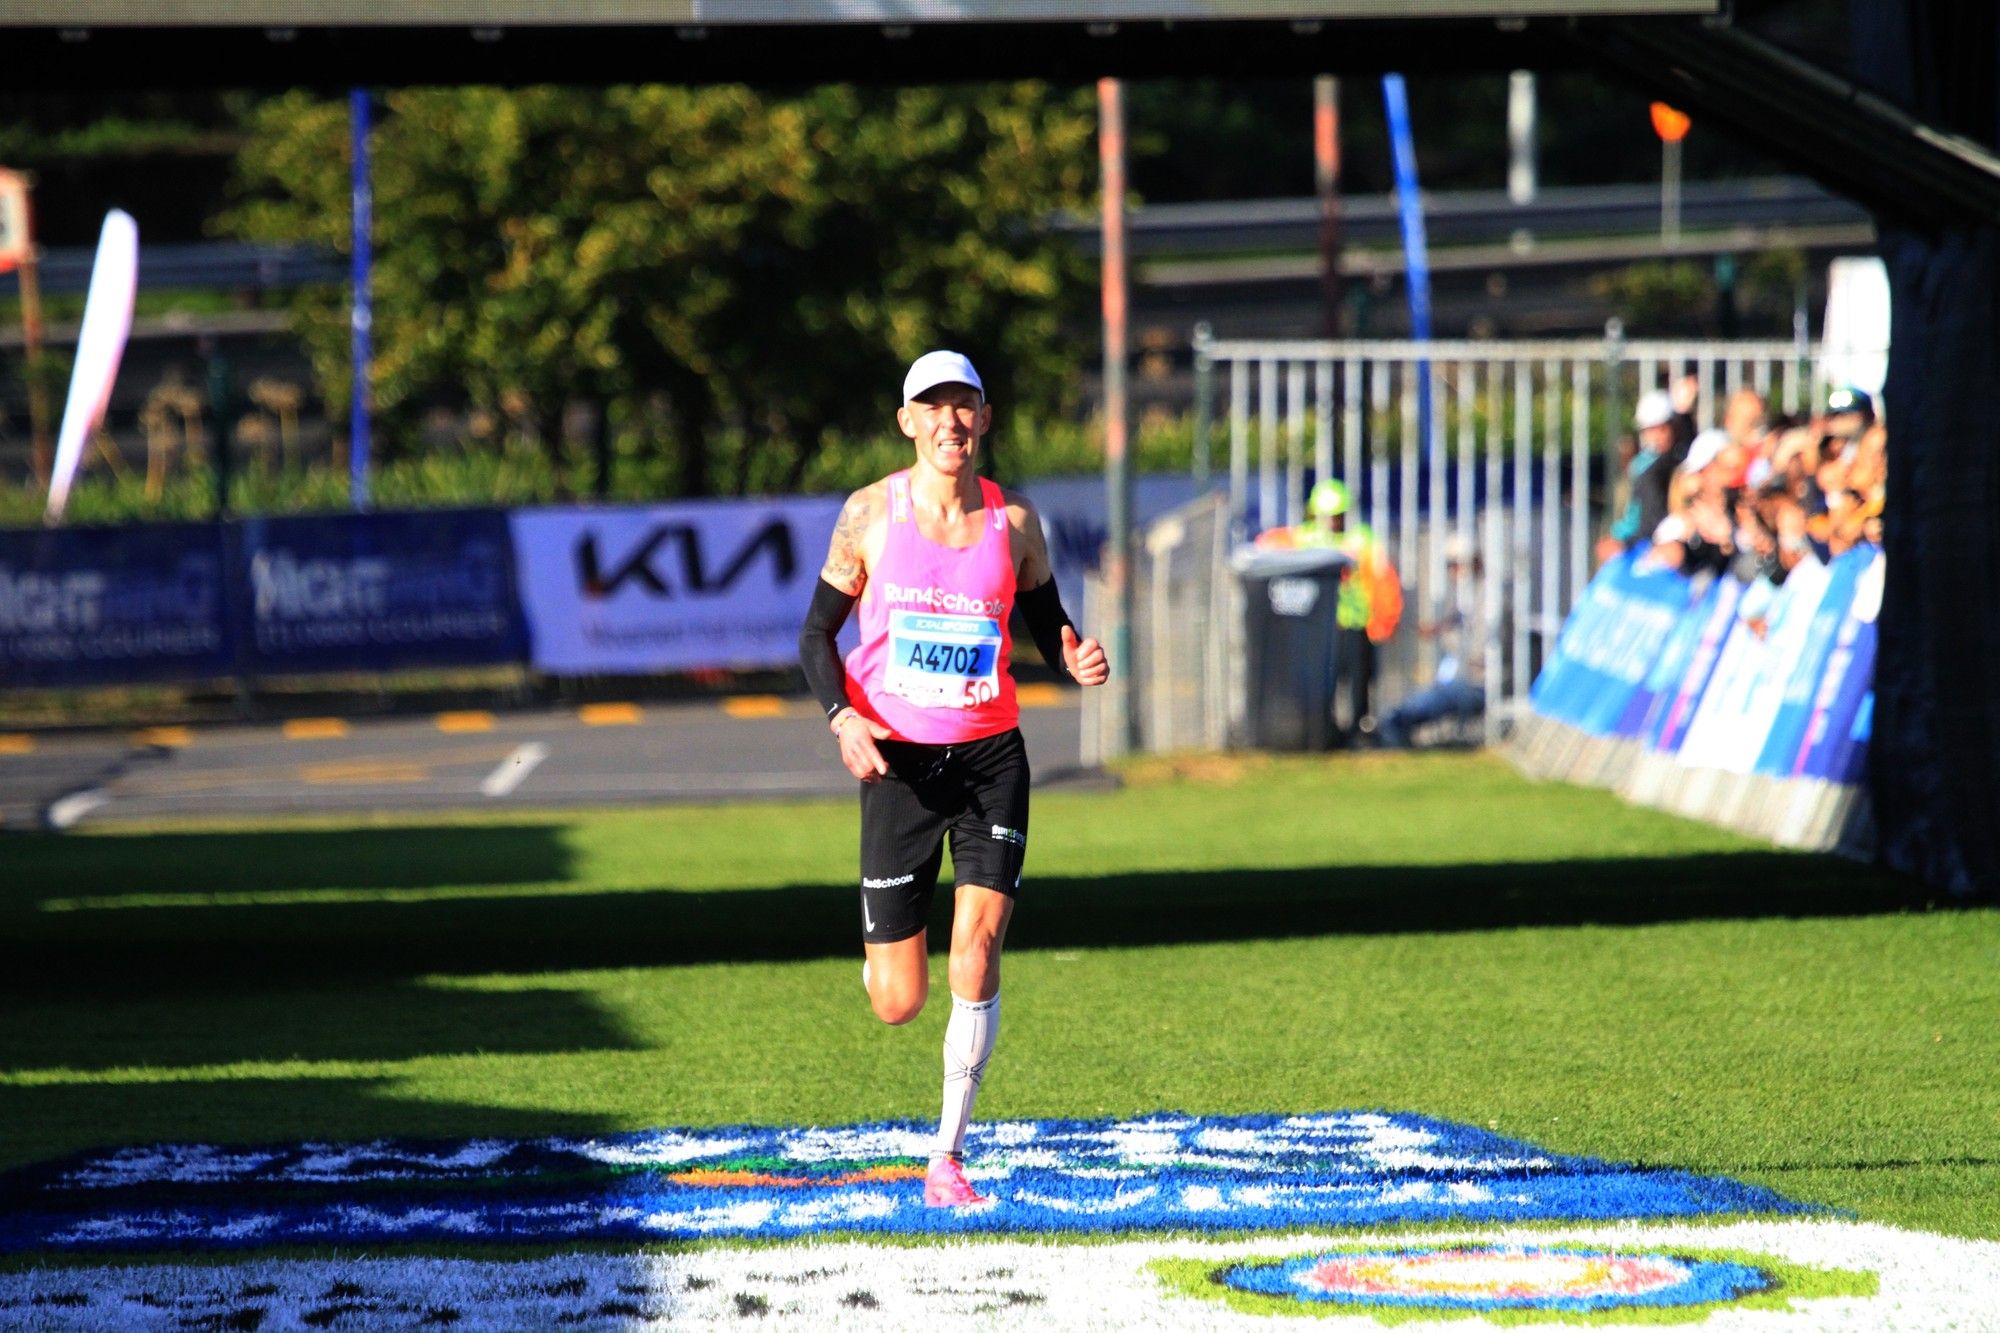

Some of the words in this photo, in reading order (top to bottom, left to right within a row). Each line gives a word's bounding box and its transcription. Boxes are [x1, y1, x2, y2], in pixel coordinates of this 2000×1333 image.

[576, 519, 799, 599] KIA
[883, 582, 1006, 615] Run4Schools
[908, 643, 981, 675] A4702
[964, 680, 993, 708] 50
